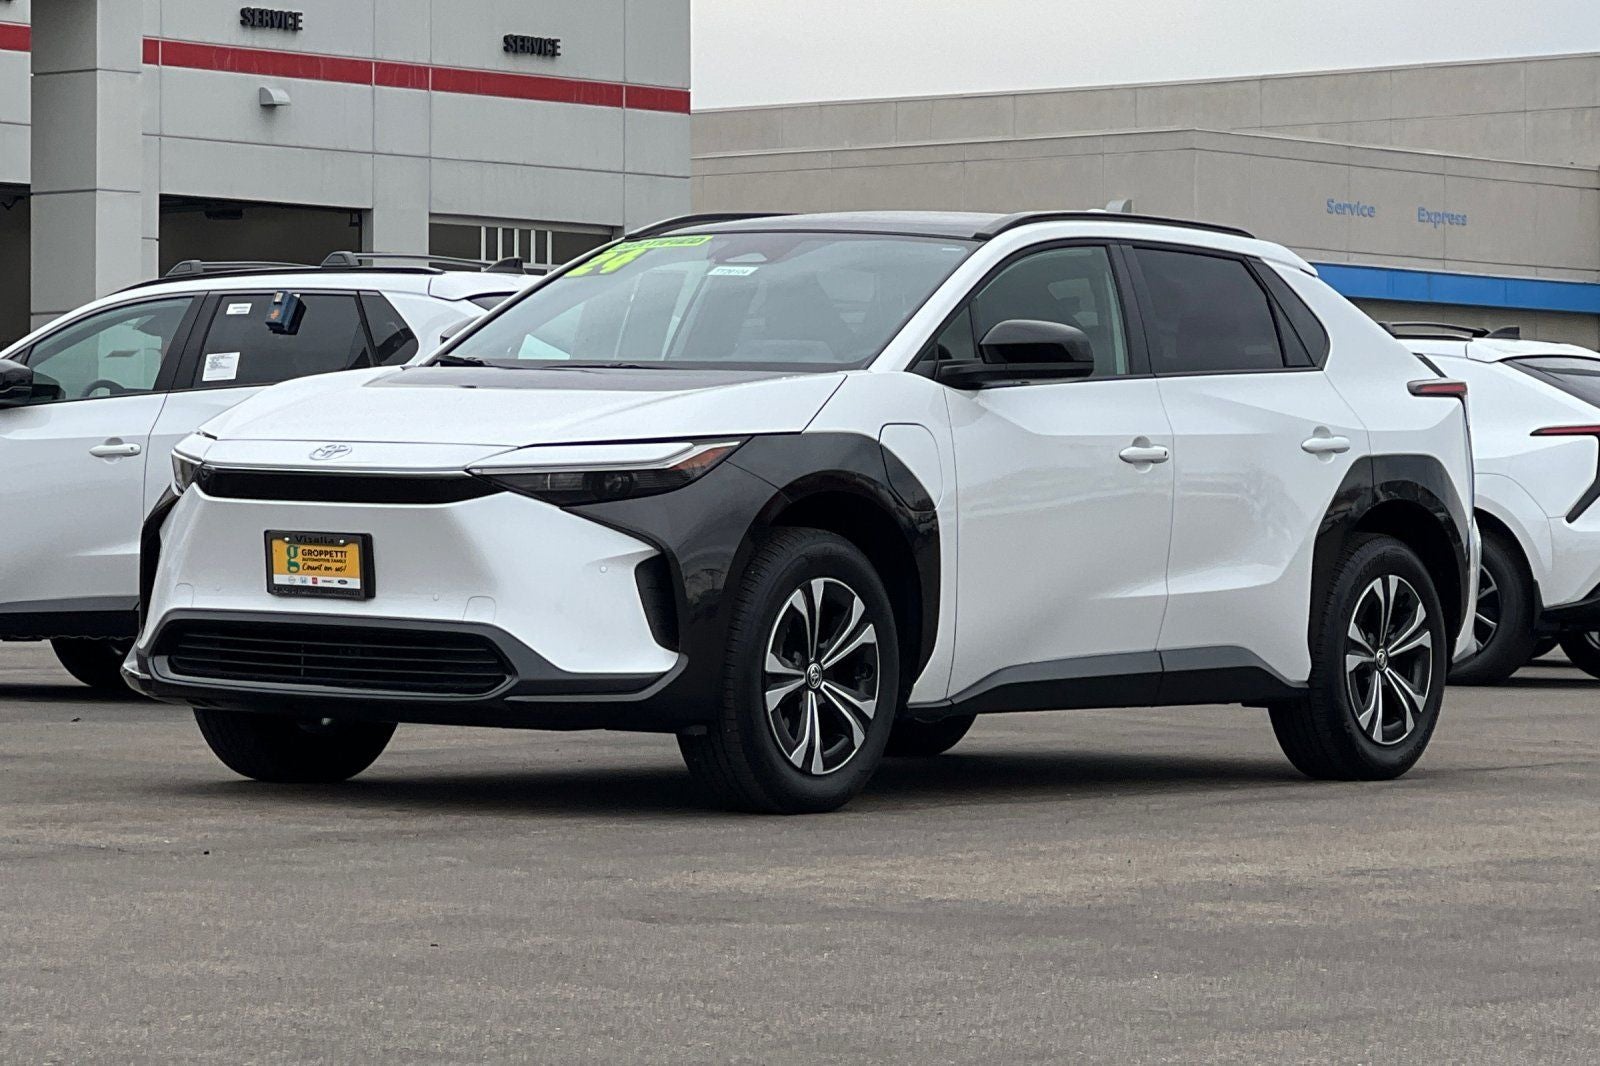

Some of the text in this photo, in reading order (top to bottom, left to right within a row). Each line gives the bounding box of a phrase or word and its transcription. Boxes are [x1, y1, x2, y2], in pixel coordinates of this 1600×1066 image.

[240, 7, 303, 31] SERVICE
[503, 34, 561, 56] SERVICE
[1326, 198, 1467, 229] Service Express
[295, 535, 335, 544] Visalia
[301, 549, 347, 558] GROPPETTI
[302, 562, 323, 572] Count
